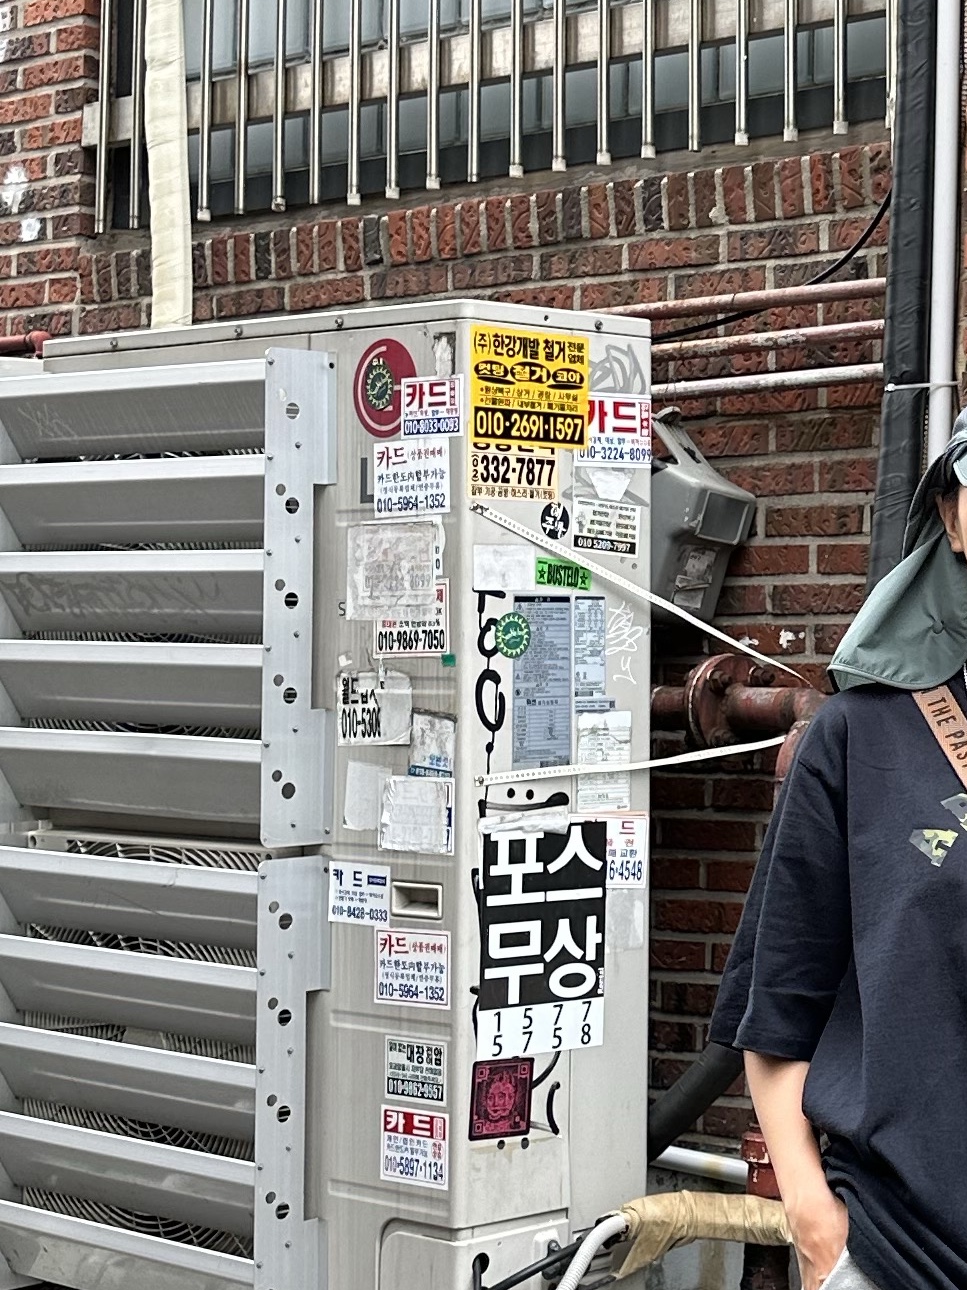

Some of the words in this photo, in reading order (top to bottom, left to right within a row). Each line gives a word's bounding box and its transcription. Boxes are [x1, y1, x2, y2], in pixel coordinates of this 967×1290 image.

[474, 331, 540, 360] (주)한강개발
[543, 338, 566, 363] 철거
[512, 365, 548, 383] 철거
[405, 381, 447, 409] 카드
[376, 446, 408, 470] 카드
[376, 492, 446, 513] 010-5964-1352
[378, 629, 445, 651] 010-9869-7050
[927, 696, 957, 728] THE
[332, 869, 363, 887] 카드
[486, 825, 604, 908] 포스
[379, 934, 409, 957] 카드
[484, 916, 603, 1005] 무상
[378, 981, 445, 1002] 010-5964-1352
[386, 1110, 431, 1137] 카드
